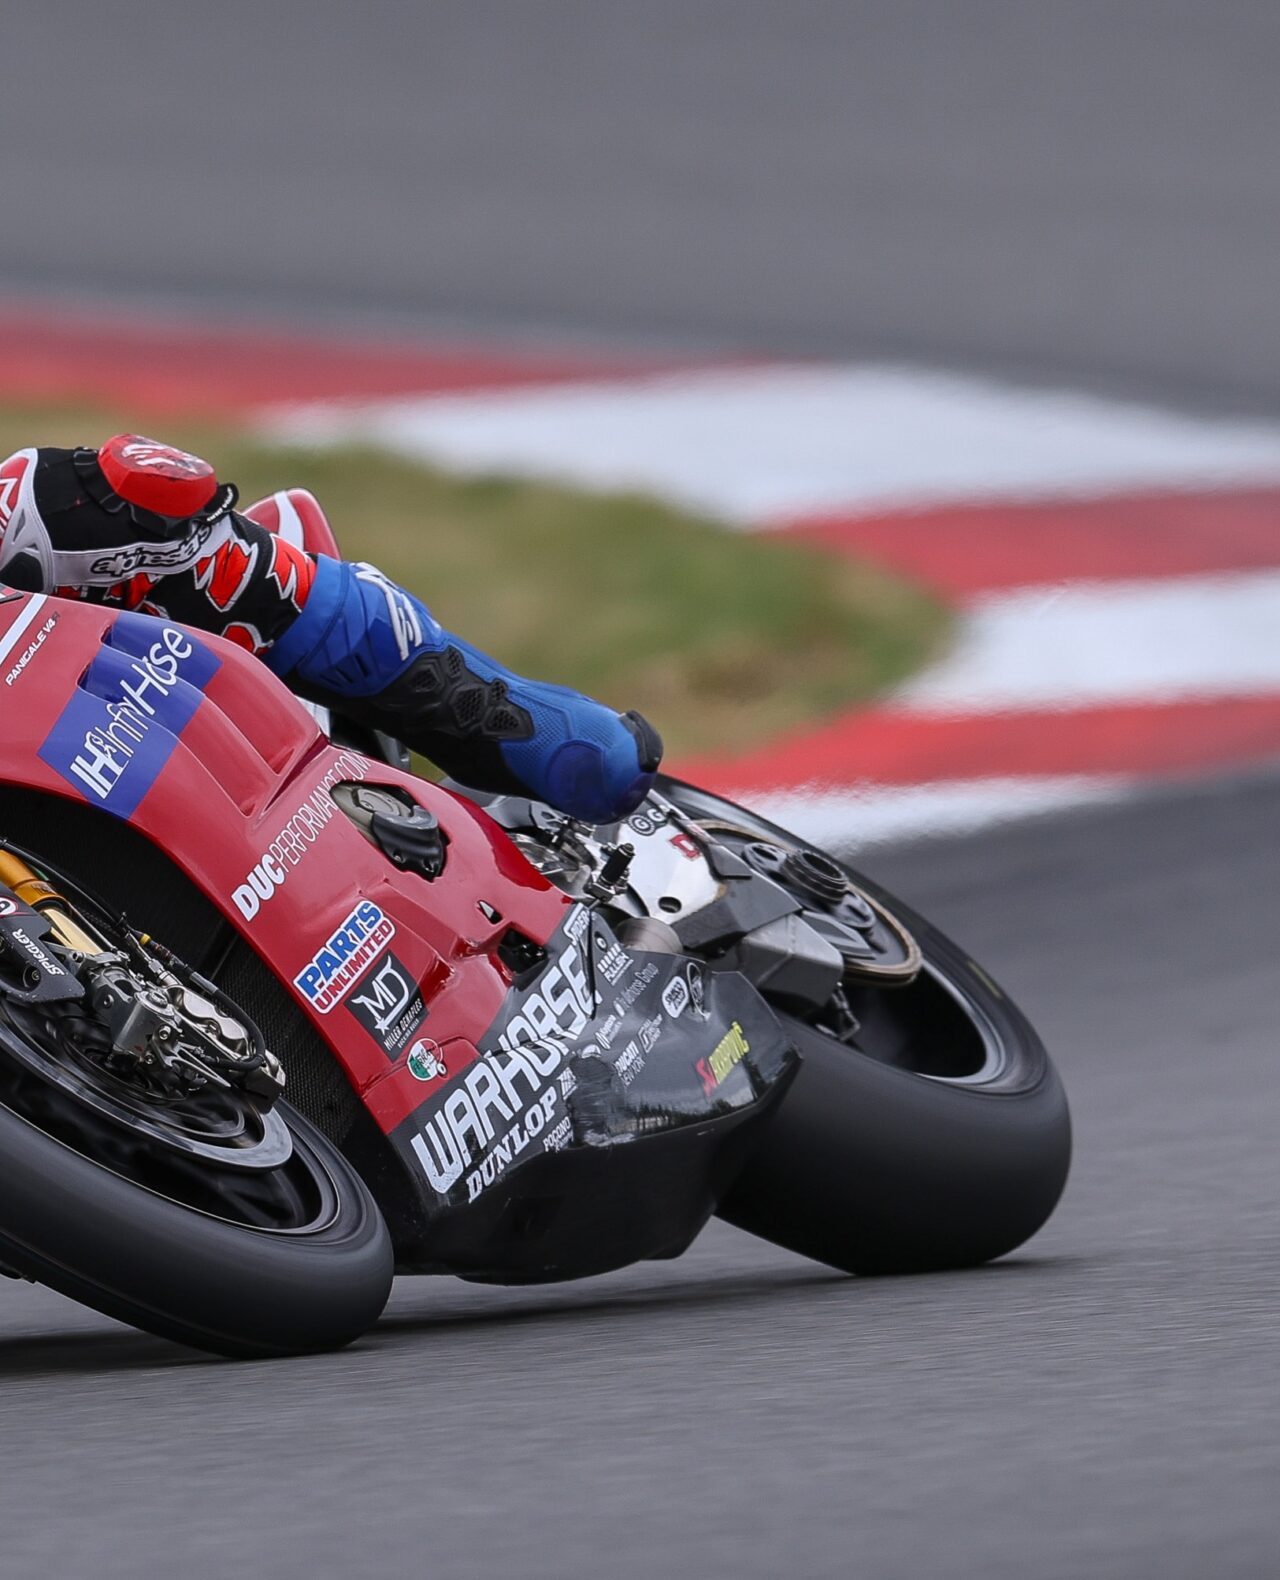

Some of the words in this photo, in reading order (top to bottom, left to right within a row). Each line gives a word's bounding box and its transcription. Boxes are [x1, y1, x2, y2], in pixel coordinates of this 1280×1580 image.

[2, 630, 48, 685] PANIGALE
[92, 627, 192, 756] InfrHose
[11, 928, 65, 977] SPIEGLER
[296, 902, 382, 998] PARTS
[316, 922, 392, 1009] UNLIMITED
[383, 1025, 403, 1052] MILLER
[410, 944, 604, 1194] WARHORSE
[613, 1040, 640, 1077] DUCATI
[464, 1085, 559, 1203] DUNLOP
[543, 1115, 572, 1152] POCONO
